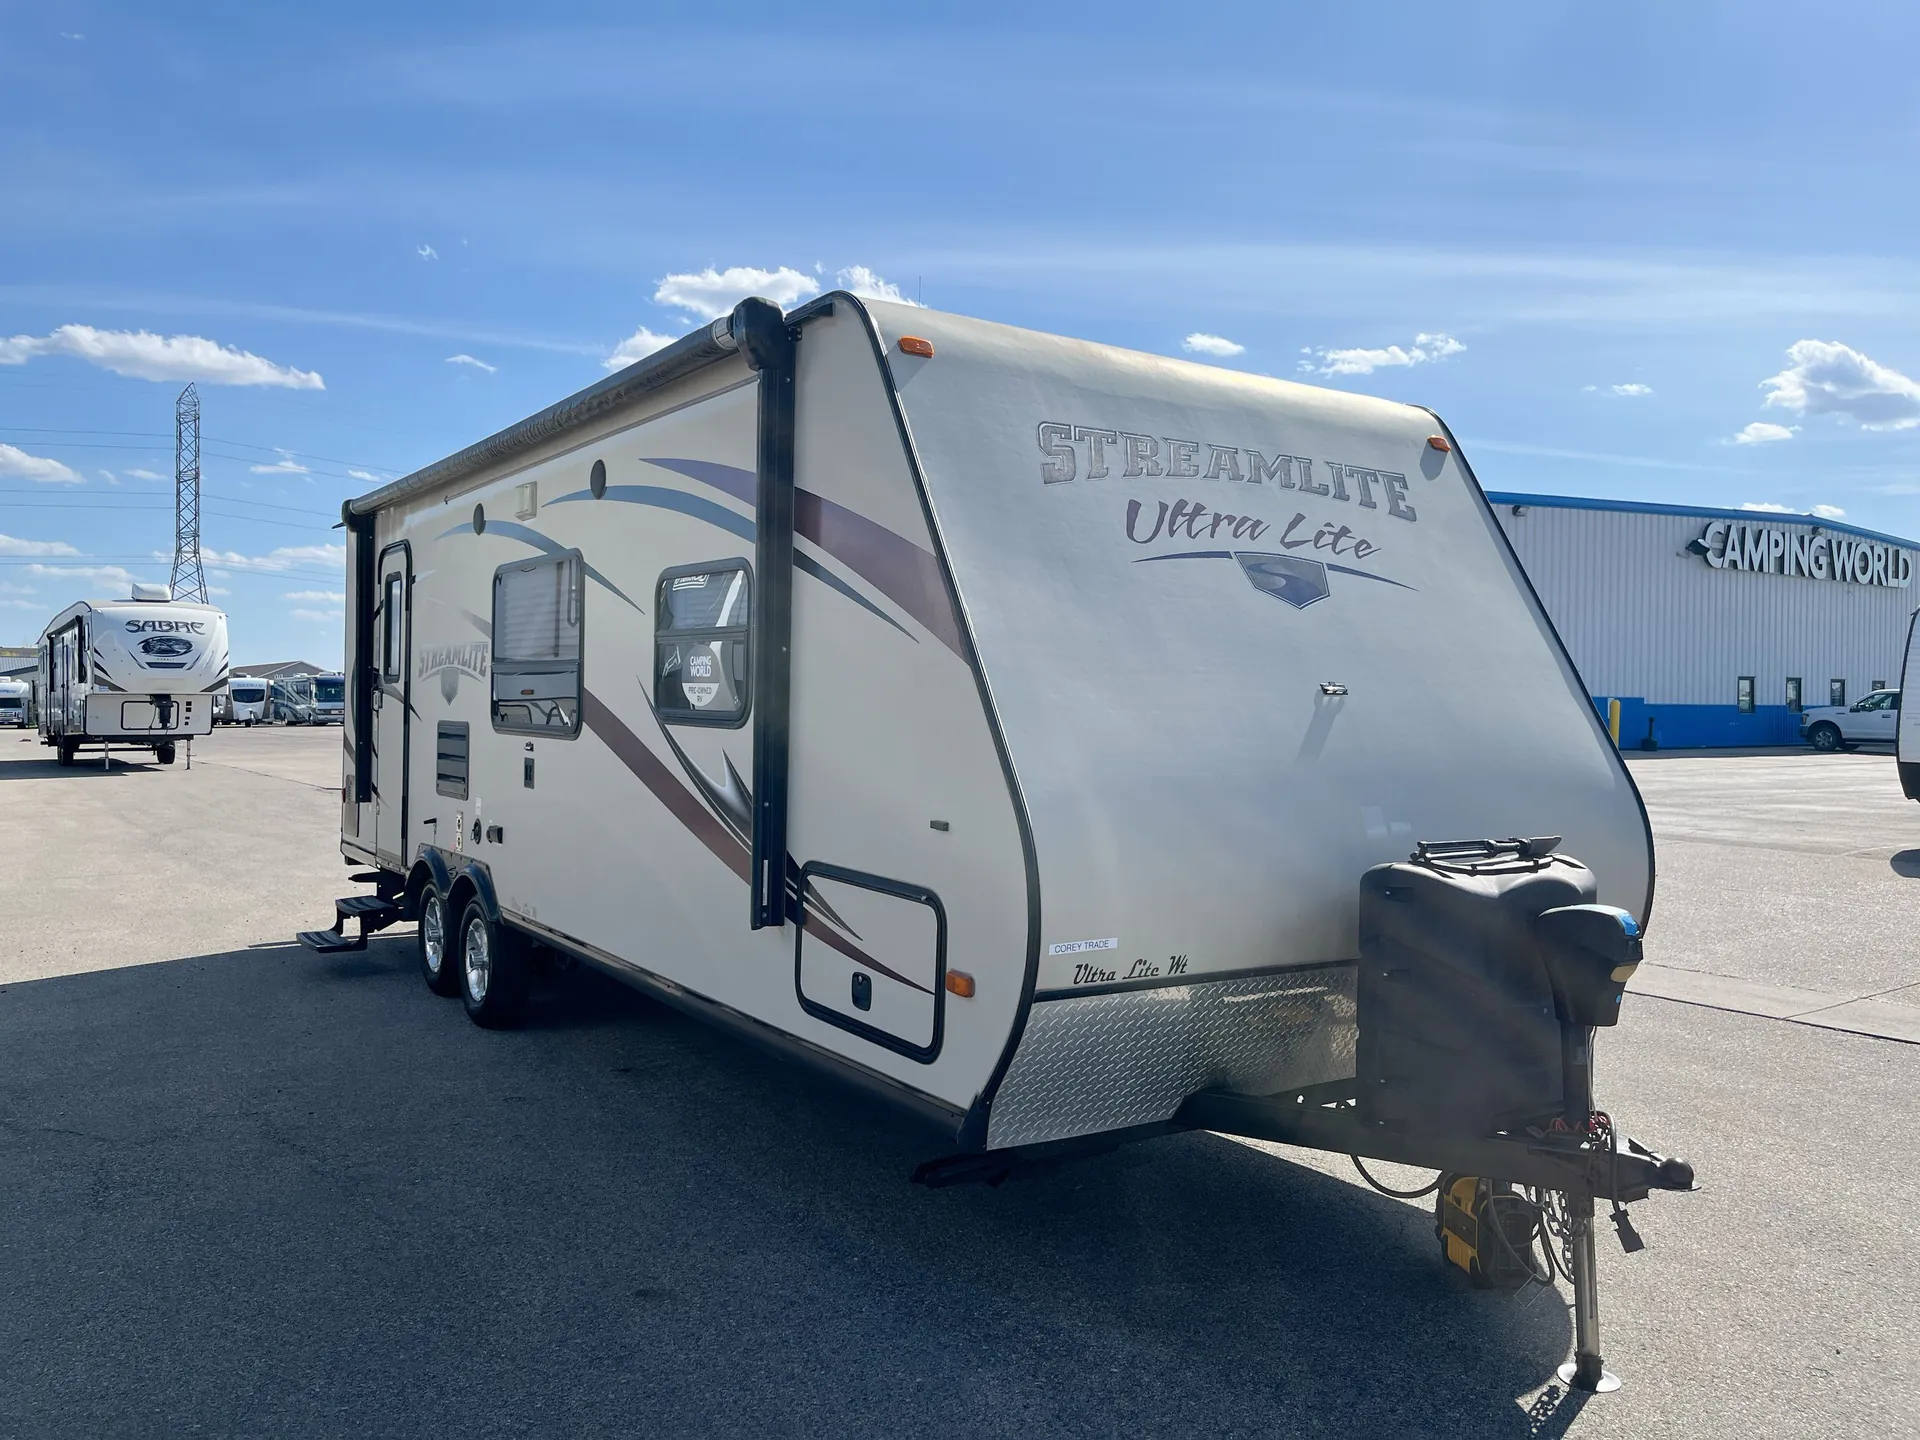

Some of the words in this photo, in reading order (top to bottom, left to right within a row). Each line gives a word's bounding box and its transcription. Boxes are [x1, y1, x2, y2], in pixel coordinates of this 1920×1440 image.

[1036, 420, 1417, 523] STREAMLITE
[1126, 498, 1270, 544] Ultra
[1279, 512, 1382, 560] Lite
[1703, 521, 1828, 580] CAMPING
[1831, 538, 1913, 589] WORLD
[125, 619, 206, 636] SABRE
[418, 641, 489, 679] STREAMLITE
[690, 655, 712, 666] CAMPING
[690, 665, 712, 678] WORLD
[688, 686, 712, 695] PRE-OWNED
[1054, 943, 1082, 954] COREY
[1084, 939, 1110, 950] TRADE
[1122, 958, 1160, 980] Lite
